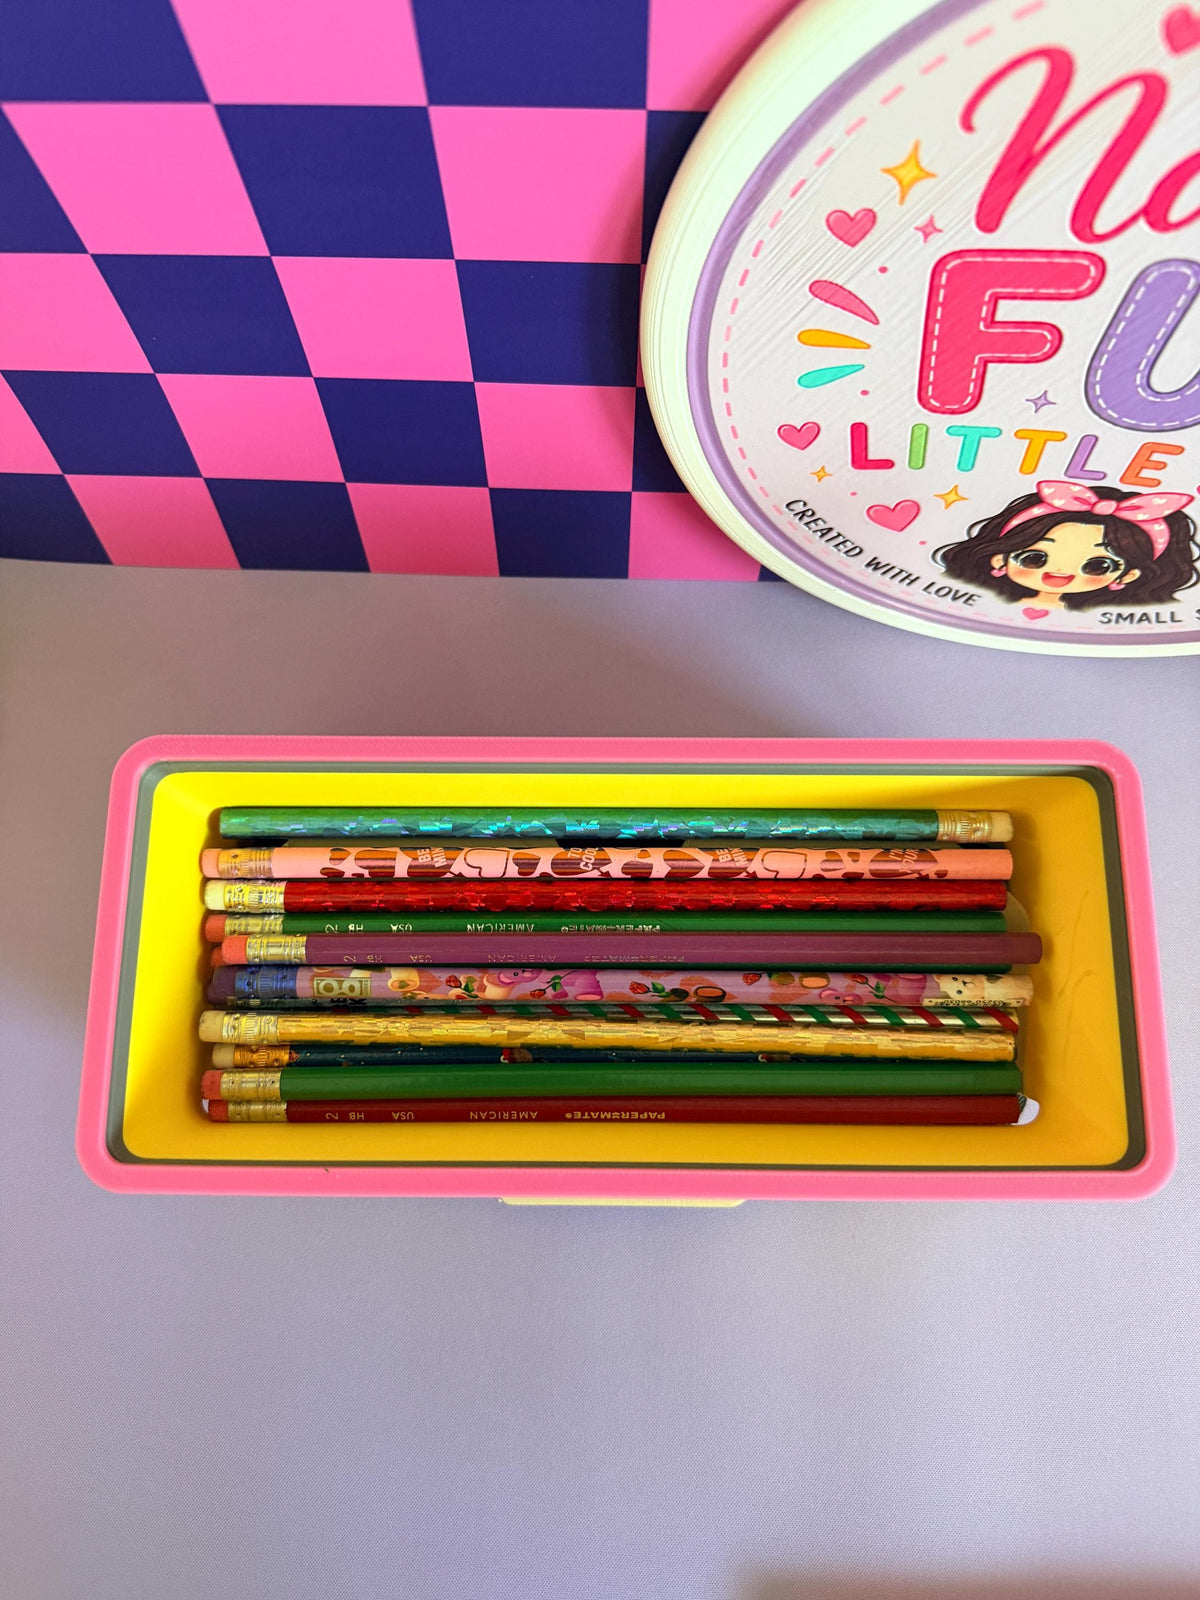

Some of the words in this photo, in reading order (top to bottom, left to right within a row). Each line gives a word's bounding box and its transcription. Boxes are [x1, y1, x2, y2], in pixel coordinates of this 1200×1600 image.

[850, 422, 1186, 488] LITTLE
[785, 499, 864, 558] CREATED
[864, 556, 921, 587] WITH
[921, 581, 982, 607] LOVE
[1098, 611, 1183, 625] SMALL
[416, 848, 432, 864] BE
[430, 847, 448, 868] MIN
[715, 848, 732, 863] BE
[348, 923, 364, 933] HB
[390, 923, 412, 933] USA
[466, 923, 535, 933] AMERICAN
[349, 1112, 365, 1121] HB
[392, 1111, 415, 1121] USA
[469, 1111, 538, 1120] AMERICAN
